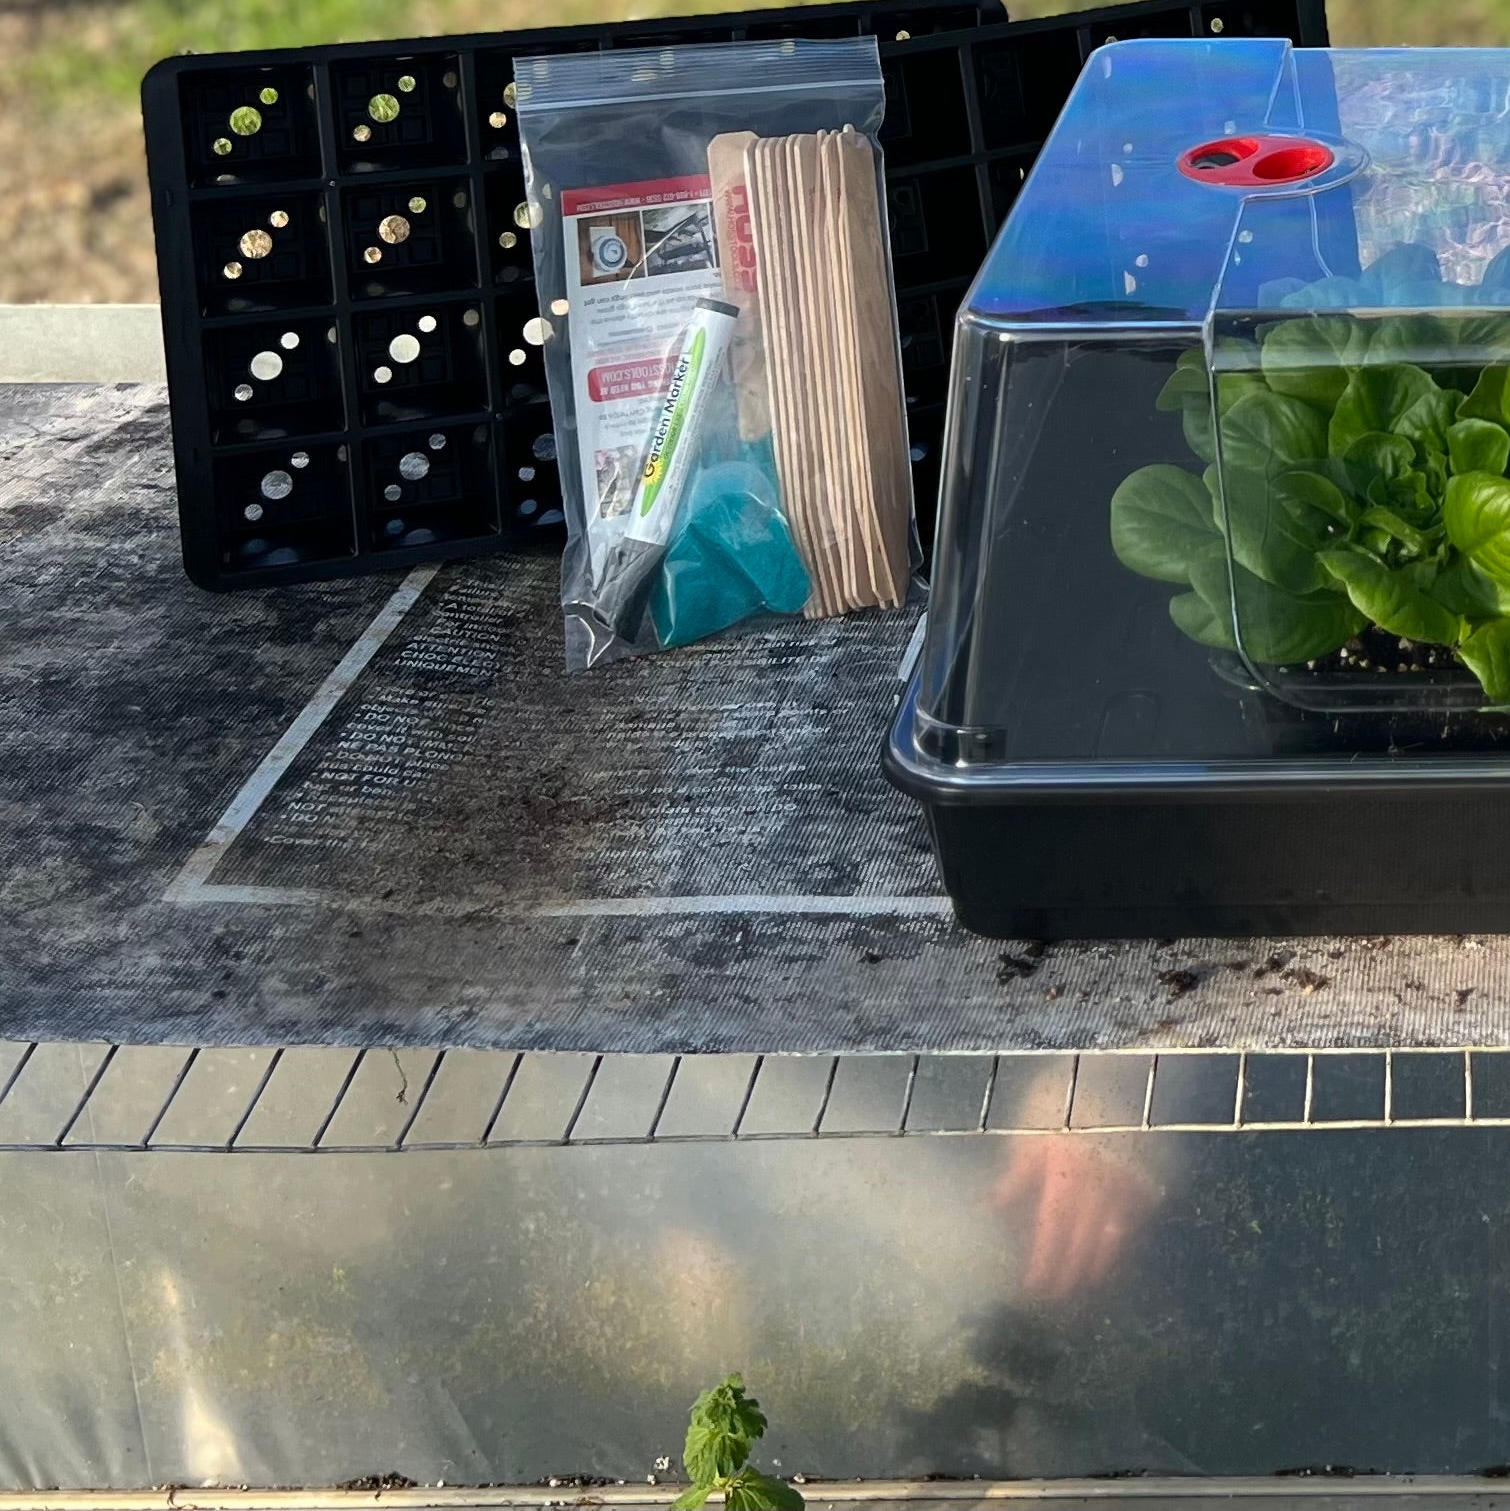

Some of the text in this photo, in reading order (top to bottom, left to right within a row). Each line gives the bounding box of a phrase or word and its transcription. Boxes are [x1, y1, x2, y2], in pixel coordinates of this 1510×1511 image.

[643, 412, 675, 479] Garden
[667, 356, 691, 411] Marker
[430, 626, 500, 642] CAUTION
[406, 642, 497, 660] ATTENTION
[379, 694, 419, 705] Make
